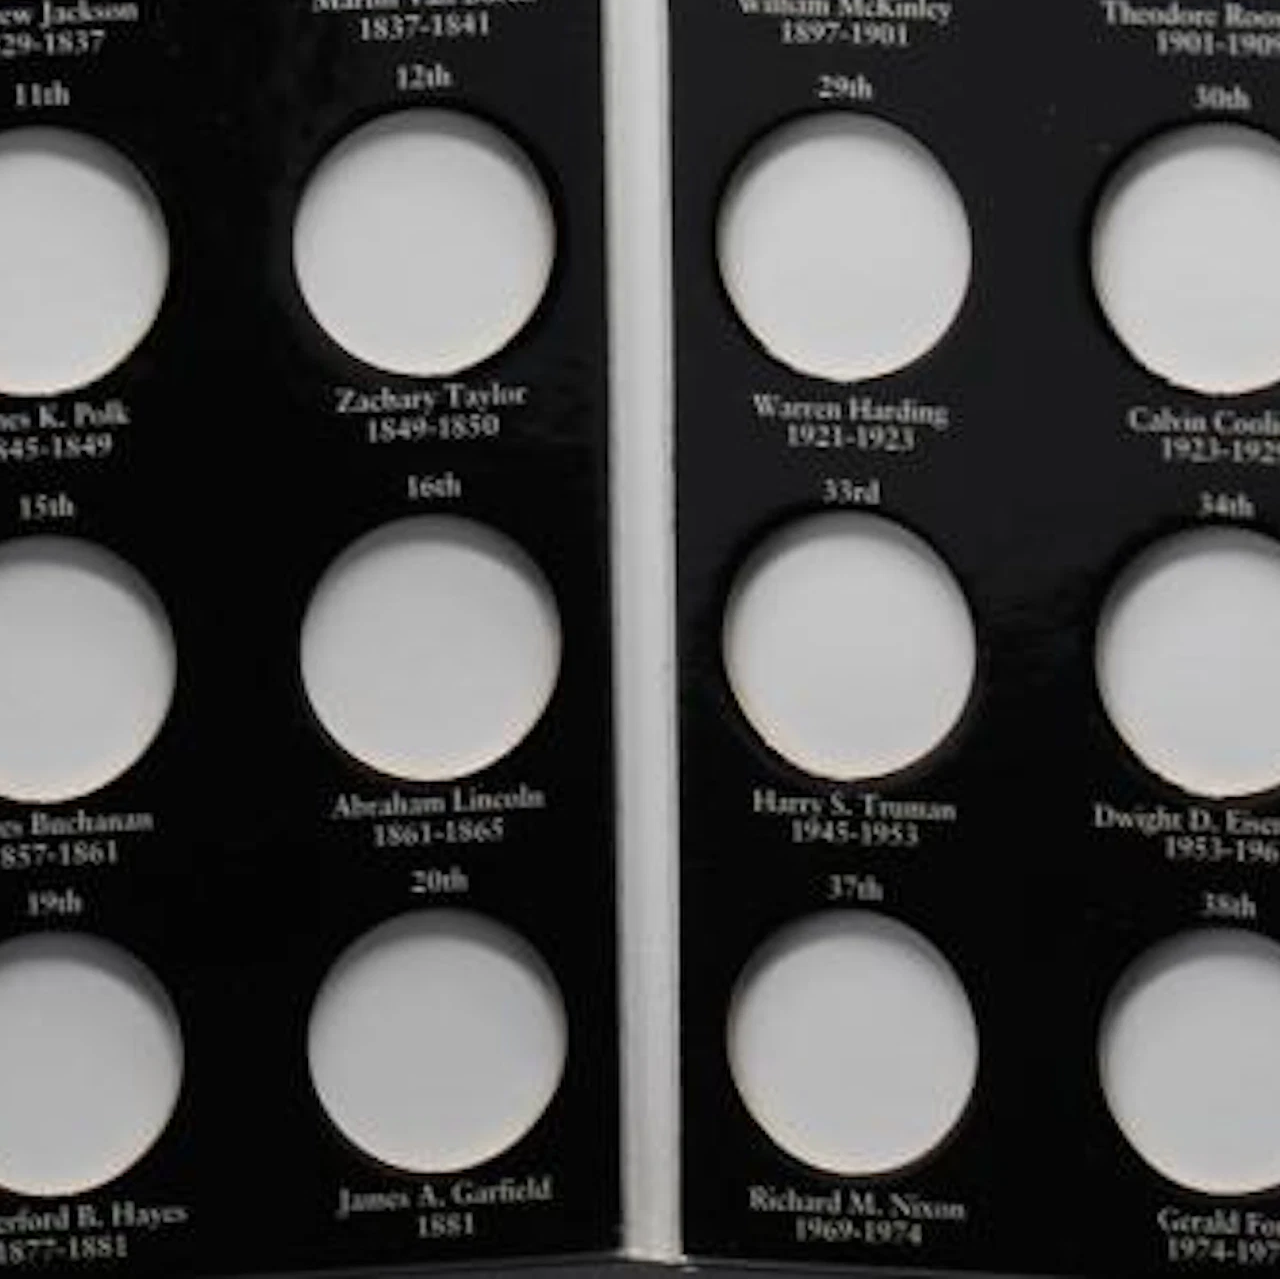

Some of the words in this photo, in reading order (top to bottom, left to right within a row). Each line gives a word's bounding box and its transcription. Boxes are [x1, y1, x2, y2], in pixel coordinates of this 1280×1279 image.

[40, 0, 138, 27] Jackson
[359, 12, 489, 41] 1837-1841
[781, 20, 908, 46] 1897-1901
[395, 64, 453, 90] 12th
[817, 75, 873, 100] 29th
[16, 82, 70, 107] 11th
[336, 387, 435, 416] Zachary
[446, 383, 527, 410] Taylor
[753, 394, 842, 421] Warren
[850, 399, 948, 429] Harding
[38, 406, 66, 431] K.
[74, 401, 130, 427] Polk
[367, 413, 499, 443] 1849-1850
[1128, 407, 1208, 434] Calvin
[787, 424, 916, 452] 1921-1923
[406, 474, 462, 499] 16th
[822, 478, 880, 505] 33rd
[19, 494, 74, 521] 15th
[332, 792, 446, 819] Abraham
[453, 784, 545, 813] Lincoln
[753, 789, 823, 817] Harry
[828, 793, 853, 816] S.
[861, 794, 956, 821] Truman
[31, 810, 154, 835] Buchanan
[1094, 804, 1181, 832] Dwight
[1188, 808, 1219, 832] D.
[373, 817, 504, 847] 1861-1865
[791, 820, 918, 846] 1945-1953
[411, 867, 469, 893] 20th
[828, 875, 883, 901] 37th
[28, 890, 82, 916] 19th
[337, 1188, 412, 1219] James
[419, 1184, 445, 1209] A.
[451, 1177, 552, 1204] Garfield
[748, 1186, 841, 1214] Richard
[847, 1190, 884, 1217] M.
[890, 1192, 965, 1220] Nixon
[76, 1203, 104, 1229] B.
[111, 1200, 189, 1227] Hayes
[419, 1211, 474, 1237] 1881
[1157, 1207, 1239, 1236] Gerald
[795, 1217, 921, 1245] 1969-1974
